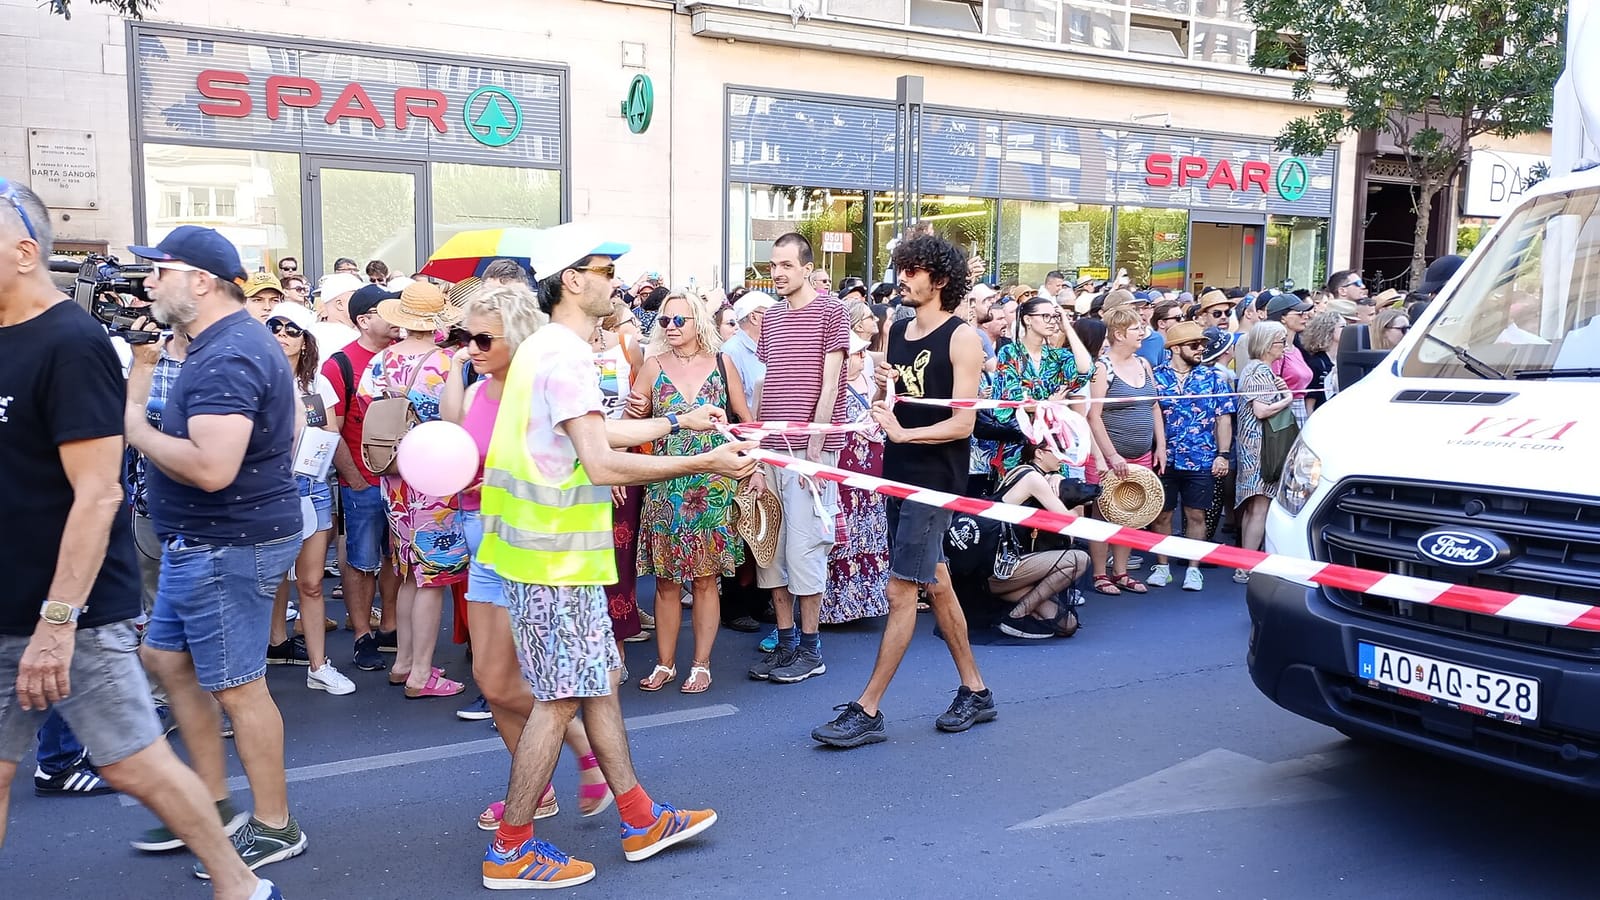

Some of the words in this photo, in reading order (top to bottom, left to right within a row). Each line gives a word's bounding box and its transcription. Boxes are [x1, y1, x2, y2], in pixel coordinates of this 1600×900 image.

[197, 70, 448, 133] SPAR
[32, 169, 60, 177] BARTA
[1145, 153, 1271, 194] SPAR
[1464, 417, 1578, 440] VIA
[1431, 535, 1482, 561] Ford
[1363, 662, 1372, 675] H
